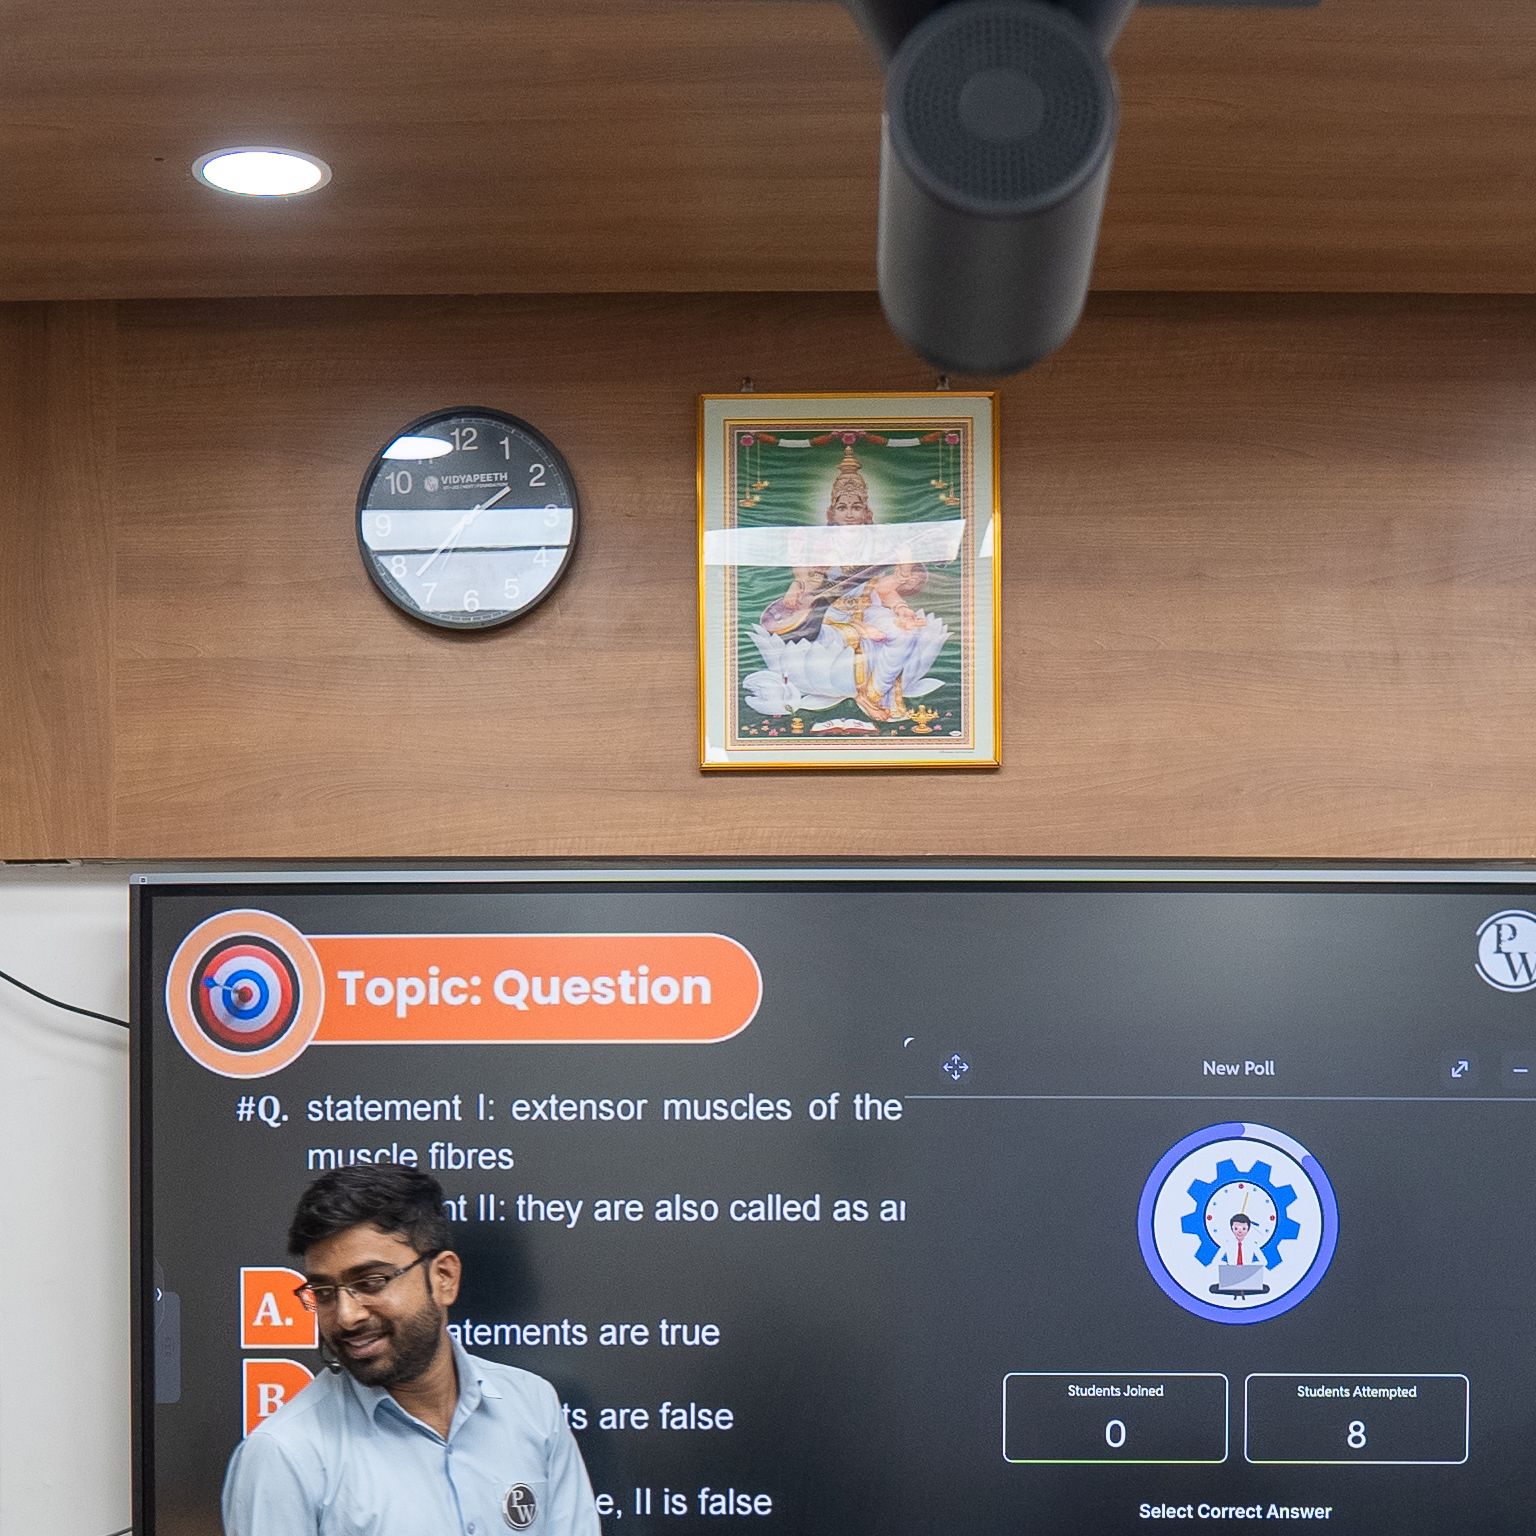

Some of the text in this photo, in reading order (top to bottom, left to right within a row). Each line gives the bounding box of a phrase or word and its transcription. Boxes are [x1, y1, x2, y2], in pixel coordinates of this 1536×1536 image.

[450, 427, 478, 451] 12
[499, 437, 510, 459] 1
[385, 471, 412, 494] 10
[441, 472, 508, 484] VIDYAPEETH
[529, 464, 546, 487] 2
[544, 504, 559, 527] 3
[391, 555, 407, 577] 8
[464, 590, 479, 612] 6
[338, 965, 711, 1018] Topic: Question
[1204, 1061, 1274, 1075] New Poll
[237, 1096, 288, 1125] #Q.
[308, 1095, 462, 1121] statement
[512, 1094, 648, 1120] extensor
[664, 1093, 791, 1120] muscles
[809, 1093, 840, 1120] of
[854, 1093, 902, 1120] the
[308, 1142, 513, 1169] muscle fibres
[517, 1194, 583, 1228] they
[594, 1200, 643, 1221] are
[655, 1194, 718, 1221] also
[730, 1194, 820, 1221] called
[833, 1200, 868, 1221] as
[252, 1292, 294, 1326] A.
[600, 1325, 649, 1345] are
[659, 1319, 720, 1345] true
[1068, 1385, 1163, 1396] Students Joined
[1298, 1385, 1417, 1400] Students Attempted
[600, 1409, 649, 1429] are
[659, 1402, 733, 1429] false
[1106, 1420, 1125, 1447] 0
[1348, 1421, 1366, 1448] 8
[664, 1488, 687, 1514] is
[698, 1487, 772, 1515] false
[1140, 1504, 1332, 1519] Select Correct Answer
